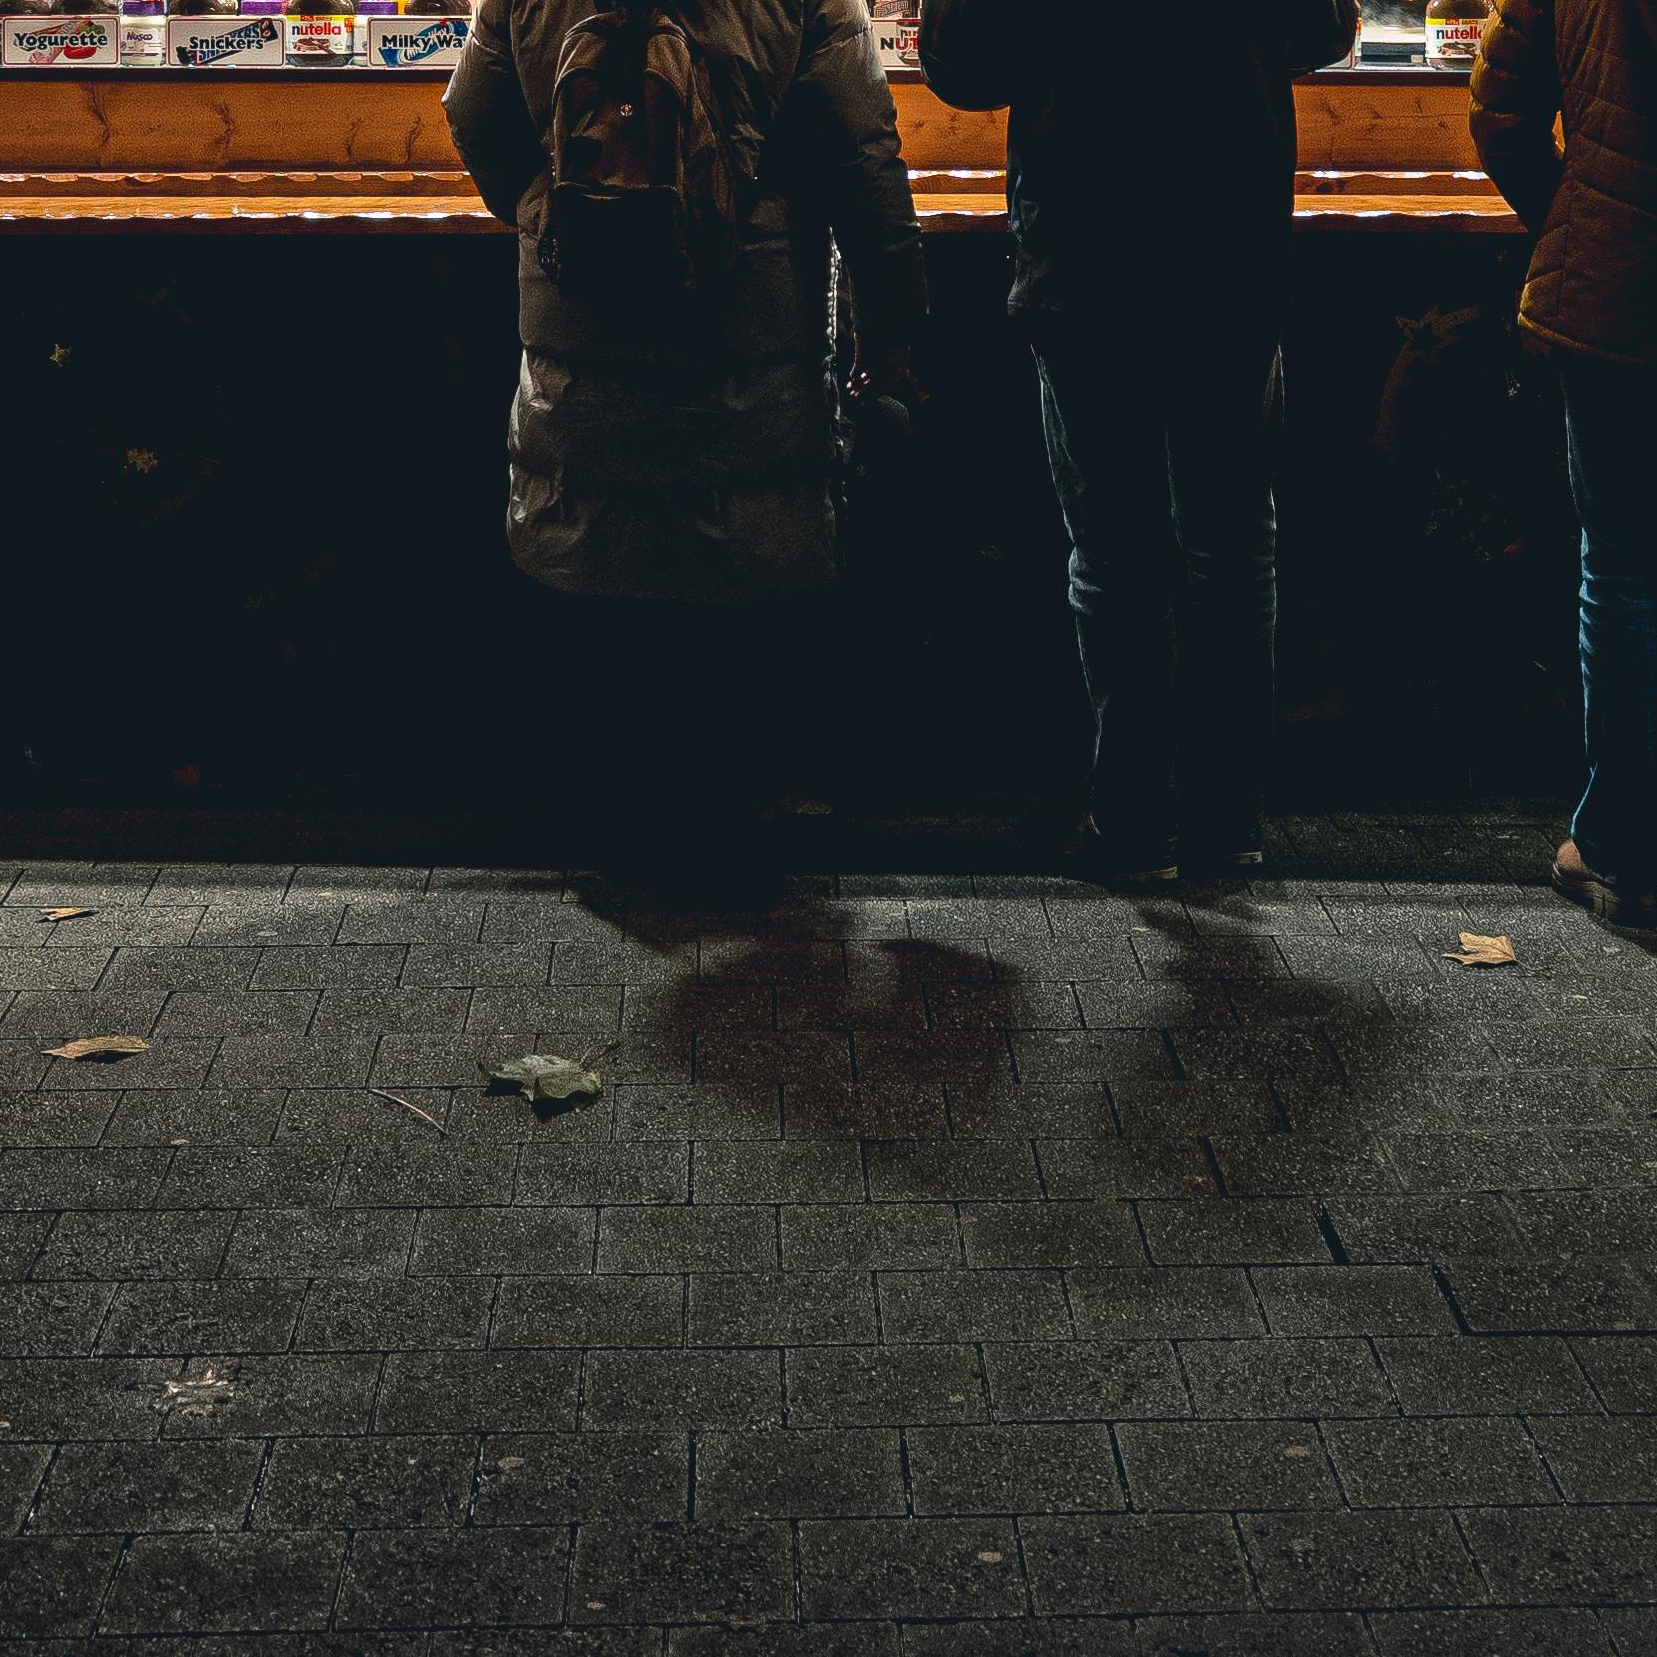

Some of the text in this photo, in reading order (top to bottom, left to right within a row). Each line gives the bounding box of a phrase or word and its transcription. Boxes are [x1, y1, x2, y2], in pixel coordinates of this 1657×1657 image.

[292, 22, 342, 36] nutella
[14, 33, 108, 50] Yogurette
[127, 32, 153, 41] Nusco
[190, 36, 264, 50] Snickers
[381, 34, 430, 51] Milky
